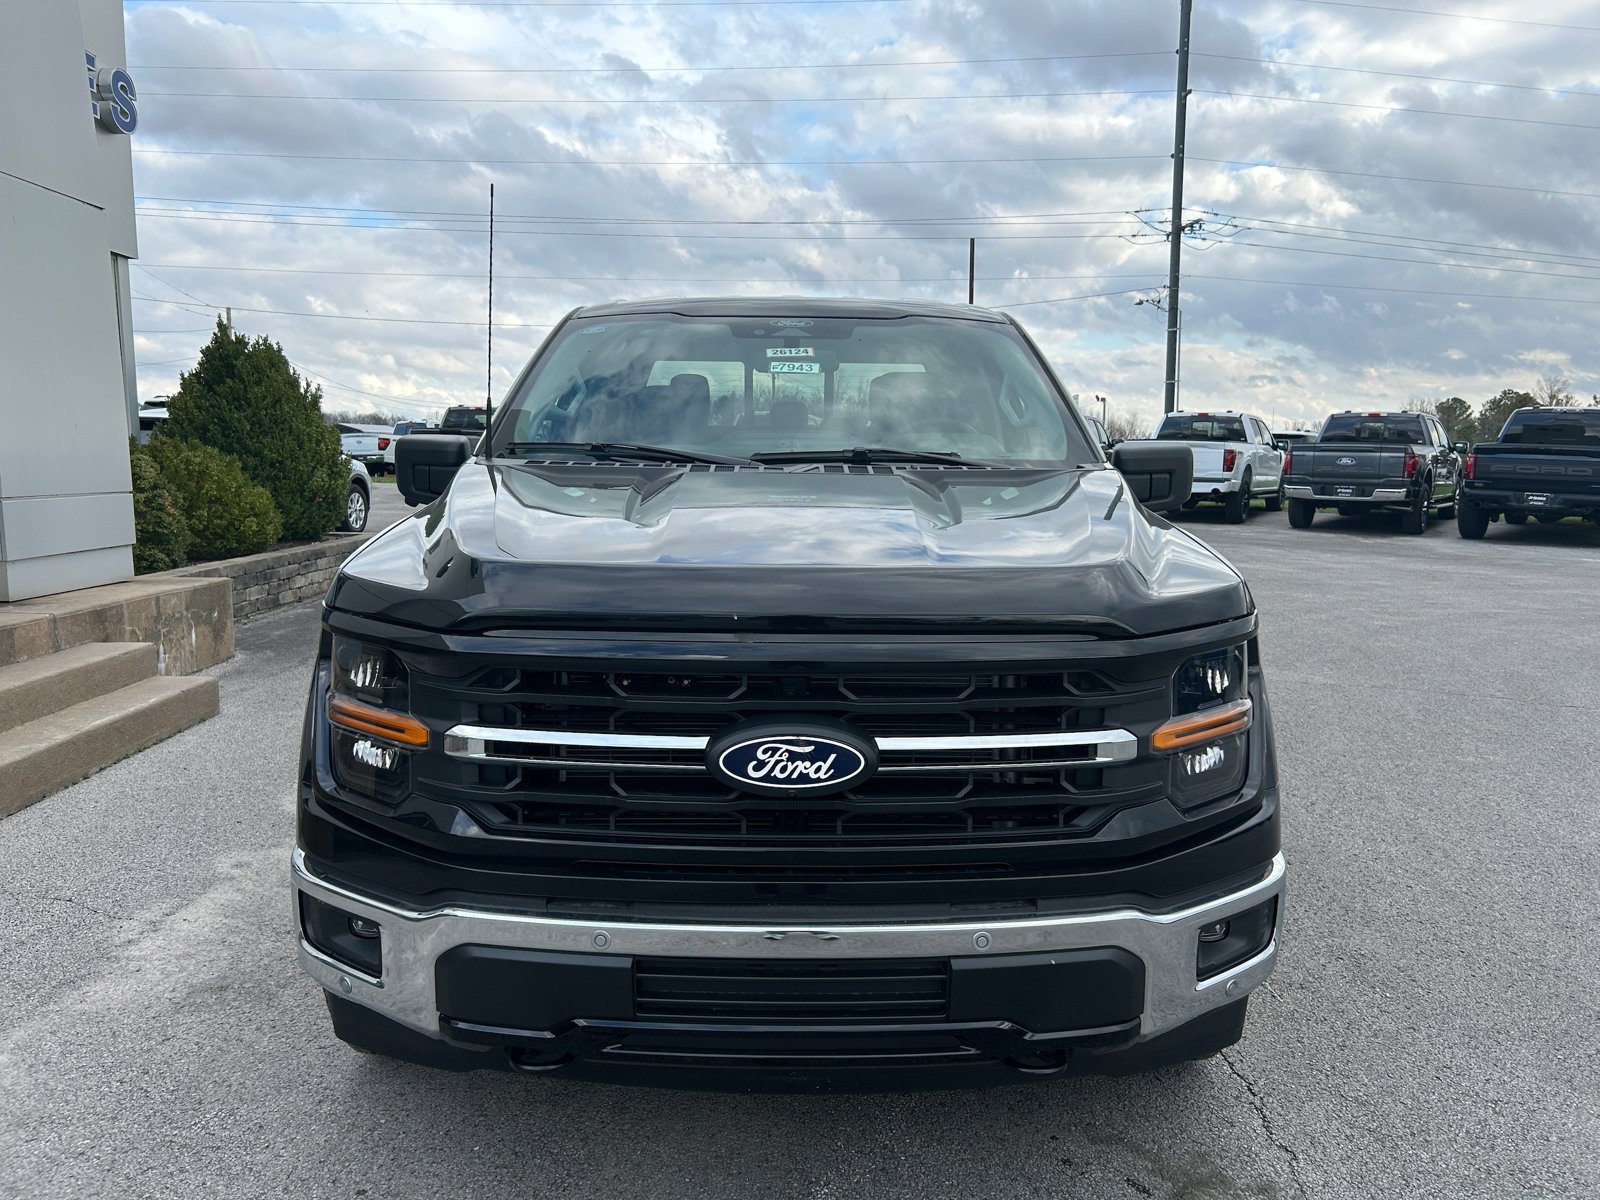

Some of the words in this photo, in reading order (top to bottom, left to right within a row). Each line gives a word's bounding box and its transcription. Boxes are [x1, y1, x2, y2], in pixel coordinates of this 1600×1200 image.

[771, 348, 810, 356] 26124
[1490, 464, 1593, 476] FORD
[747, 743, 838, 780] Ford
